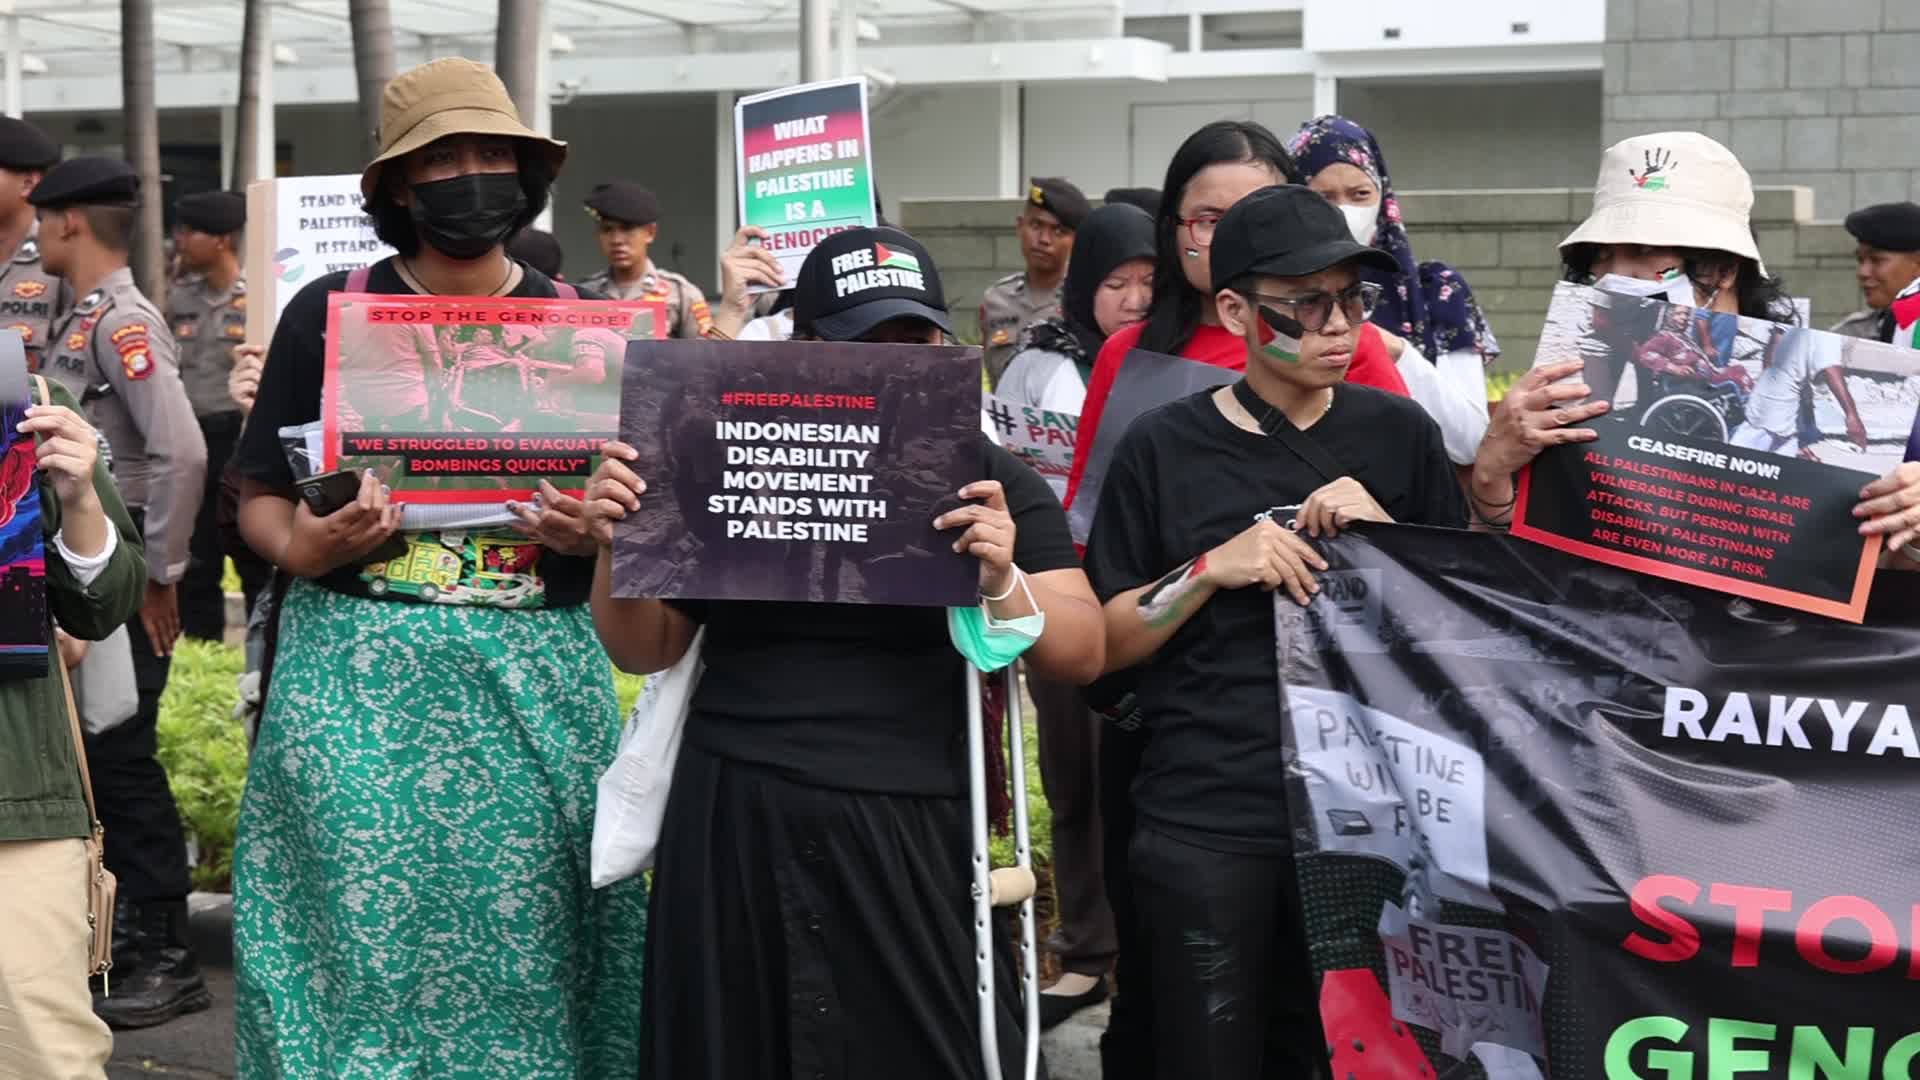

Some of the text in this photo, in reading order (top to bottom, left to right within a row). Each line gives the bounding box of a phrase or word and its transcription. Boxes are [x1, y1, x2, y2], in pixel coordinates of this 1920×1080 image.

[773, 115, 828, 141] WHAT
[748, 139, 859, 173] HAPPENS IN
[755, 168, 855, 199] PALESTINE
[300, 194, 345, 208] STAND
[785, 199, 826, 221] IS A
[315, 240, 378, 254] IS STAND
[760, 225, 857, 251] GENOC
[831, 248, 875, 275] FREE
[835, 268, 926, 297] PALESTINE
[1, 302, 48, 316] POLRI
[371, 311, 628, 326] STOP THE GENOCIDE!
[721, 392, 876, 410] #FREEPALESTINE
[388, 438, 488, 451] STRUGGLED
[493, 438, 515, 451] TO
[716, 421, 880, 443] INDONESIAN
[410, 458, 585, 473] BOMBINGS QUICKLY"
[727, 446, 870, 468] DISABILITY
[1628, 436, 1781, 480] CEASEFIRE NOW!
[723, 471, 873, 493] MOVEMENT
[1584, 451, 1812, 511] ALL PALESTINIANS IN GAZA ARE
[708, 495, 887, 518] STANDS WITH
[1591, 471, 1796, 527] VULNERABLE DURING ISRAEL
[1586, 490, 1792, 544] ATTACKS, BUT PERSON WITH
[727, 520, 868, 542] PALESTINE
[1591, 509, 1775, 560] DISABILITY PALESTINIANS
[1592, 528, 1767, 578] ARE EVEN MORE AT RISK.
[1320, 576, 1368, 601] TAND
[1662, 686, 1920, 758] RAKYA
[1415, 788, 1453, 824] BE
[1604, 1016, 1920, 1080] GEN
